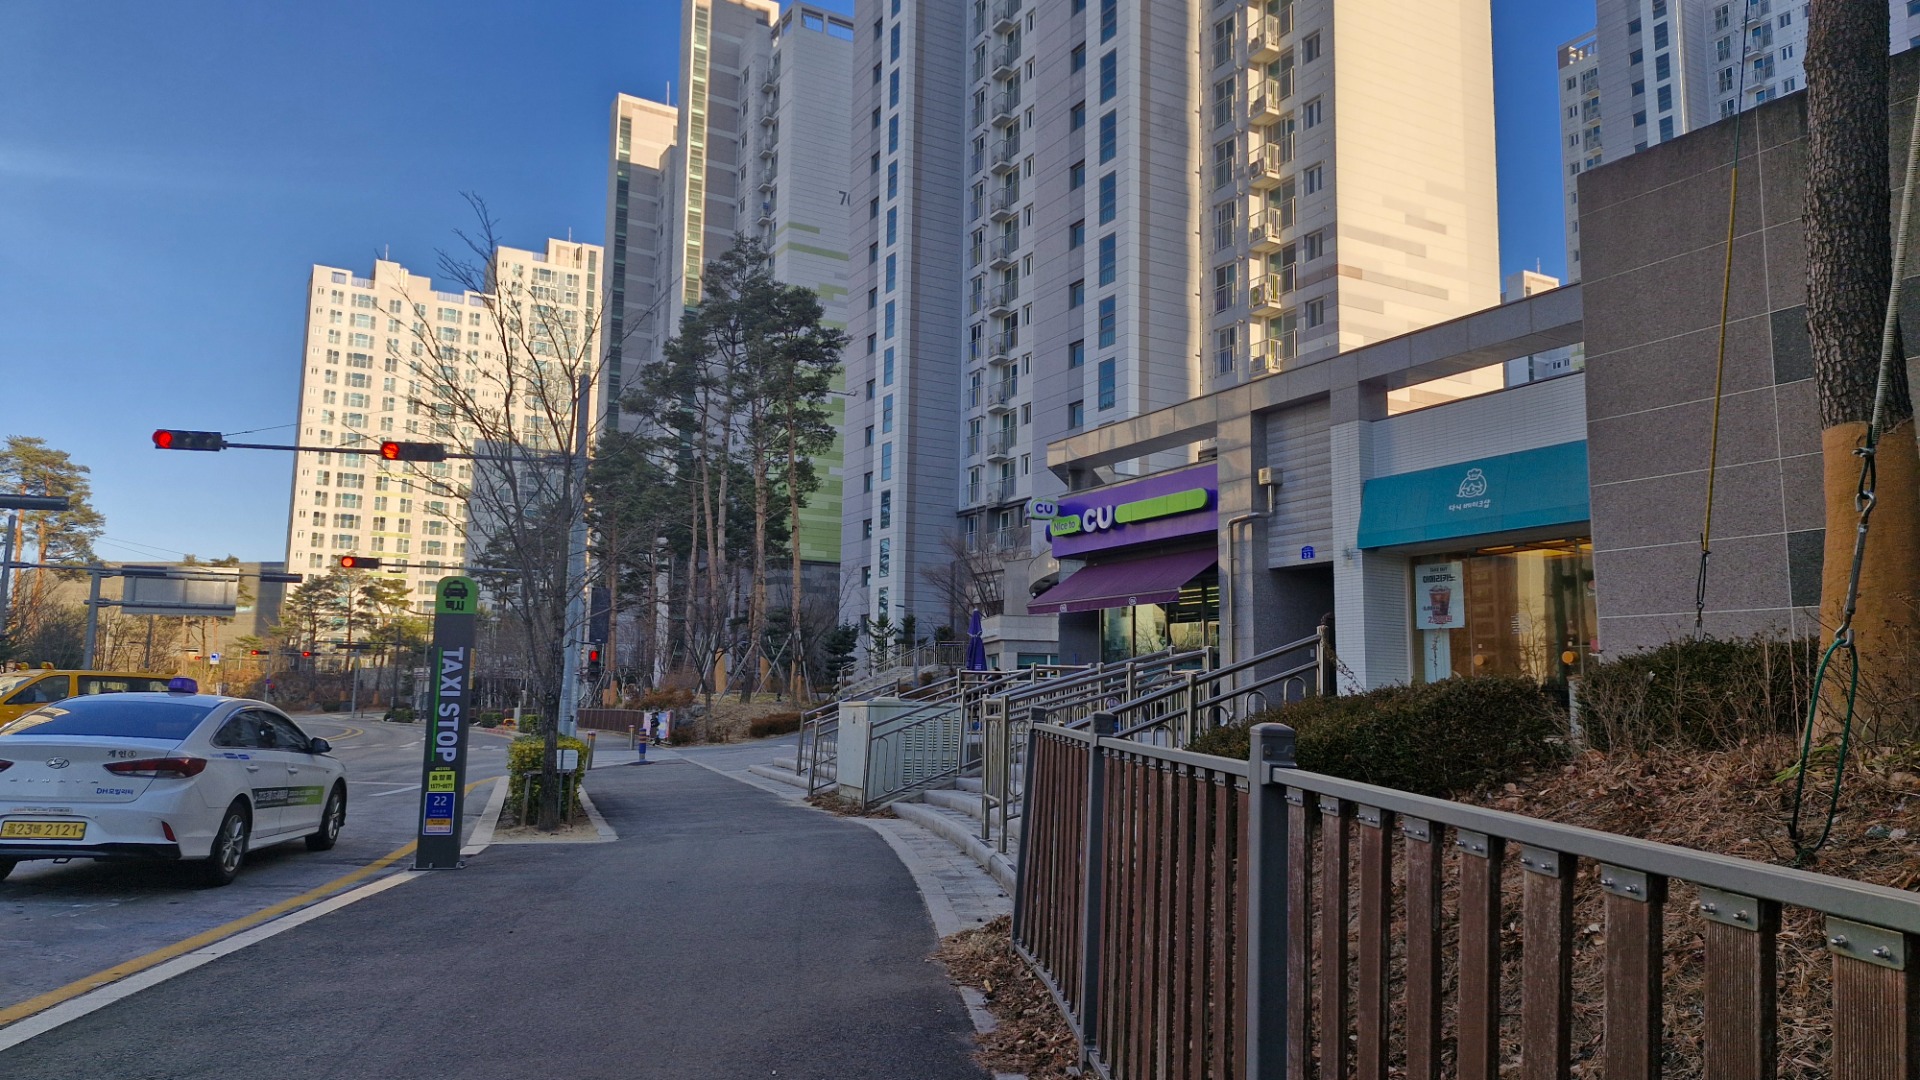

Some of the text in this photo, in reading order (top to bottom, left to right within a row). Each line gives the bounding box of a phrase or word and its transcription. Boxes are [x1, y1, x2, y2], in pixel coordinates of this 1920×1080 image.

[839, 190, 850, 206] 7
[1036, 503, 1053, 514] CU
[1053, 505, 1113, 533] Nice to CU
[1423, 574, 1456, 583] 아메리카노
[445, 600, 465, 611] 택시
[440, 647, 464, 697] TAXI
[436, 702, 460, 762] STOP
[433, 796, 447, 806] 22
[44, 823, 78, 836] 2121
